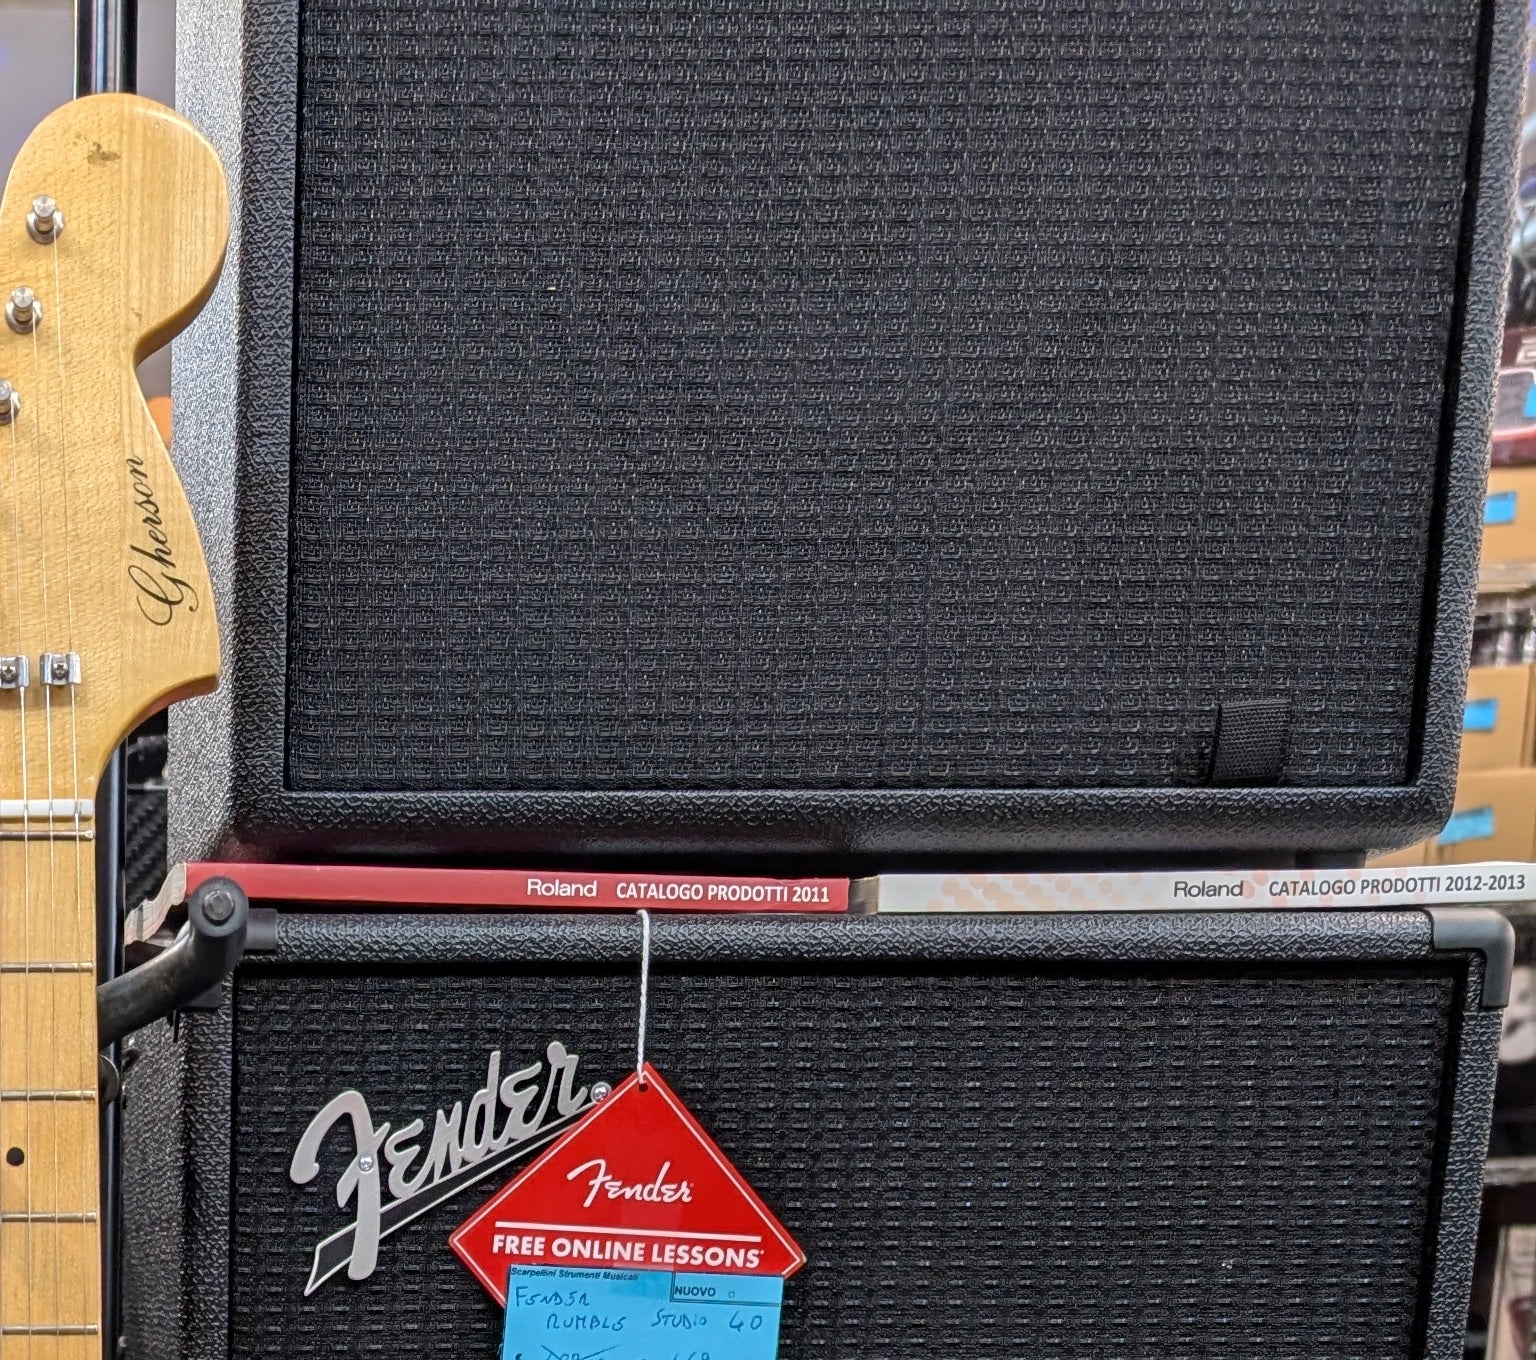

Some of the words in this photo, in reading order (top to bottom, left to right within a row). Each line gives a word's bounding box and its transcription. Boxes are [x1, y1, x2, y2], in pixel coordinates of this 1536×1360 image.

[125, 454, 200, 626] Gherson
[526, 877, 598, 897] Roland
[616, 882, 703, 901] CATALOGO
[707, 884, 788, 903] PRODOTTI
[792, 886, 830, 903] 2011
[1173, 880, 1244, 898] Roland
[1268, 879, 1356, 897] CATALOGO
[1361, 877, 1441, 895] PRODOTTI
[1445, 874, 1526, 893] 2012-2013
[289, 1041, 588, 1281] Fender
[566, 1158, 693, 1208] Fender
[492, 1233, 545, 1256] FREE
[551, 1238, 645, 1262] ONLINE
[651, 1243, 760, 1269] LESSONS
[674, 1286, 716, 1297] NUOVO
[729, 1310, 763, 1332] 40
